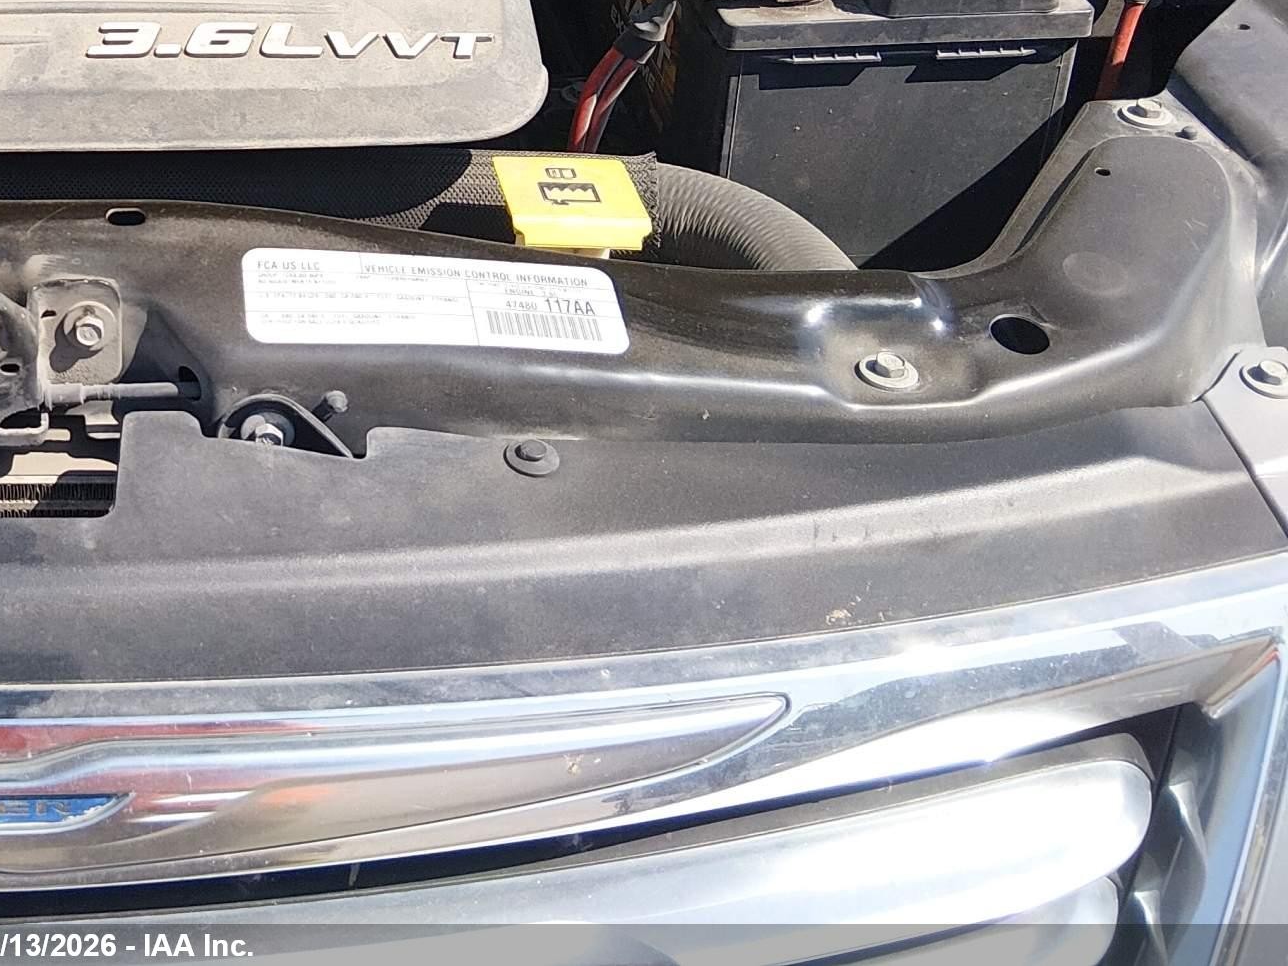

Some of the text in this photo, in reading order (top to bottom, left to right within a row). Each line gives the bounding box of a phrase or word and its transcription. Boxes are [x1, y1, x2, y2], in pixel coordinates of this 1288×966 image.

[86, 21, 495, 61] 3.6L VVT
[257, 261, 321, 271] FCA US LLC
[364, 264, 407, 275] VEHICLE
[411, 266, 461, 278] EMISSION
[465, 269, 511, 282] CONTROL
[516, 273, 588, 287] INFORMATION
[544, 297, 596, 315] 117AA
